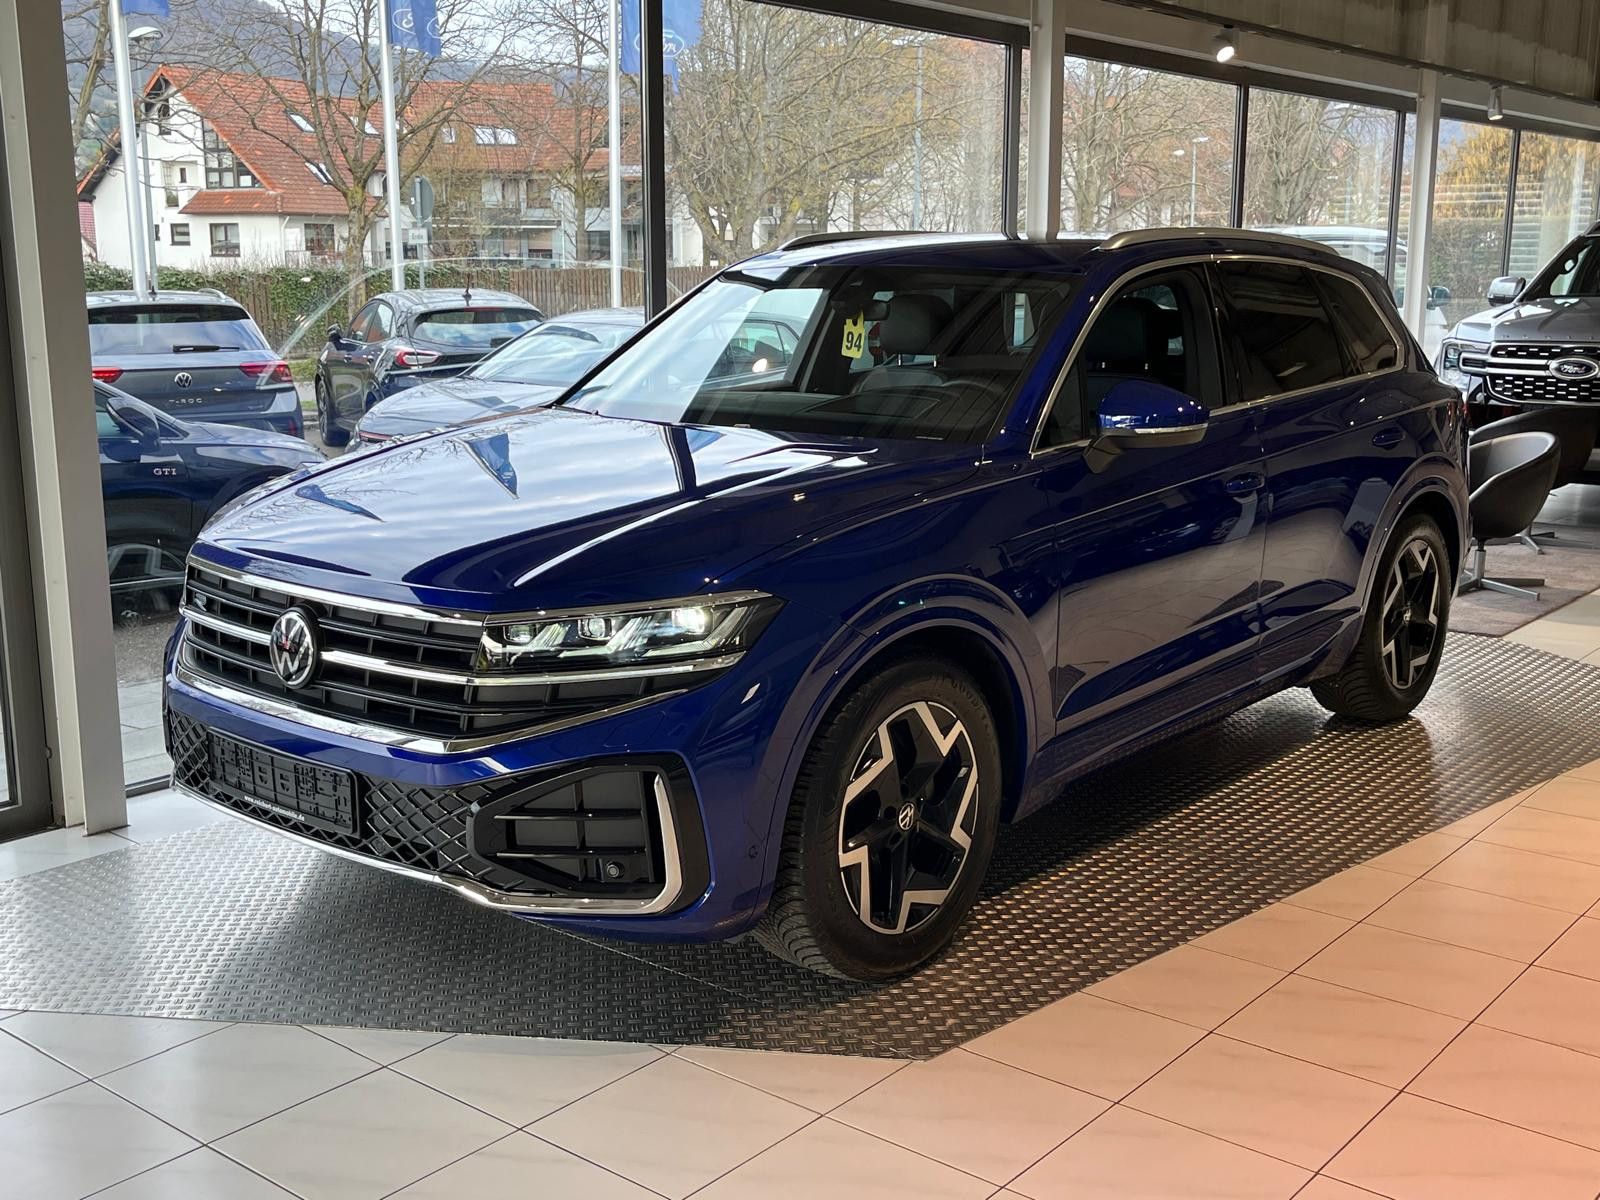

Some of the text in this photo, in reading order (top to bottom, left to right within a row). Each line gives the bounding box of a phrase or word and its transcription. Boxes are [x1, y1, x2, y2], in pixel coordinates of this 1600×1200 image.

[845, 331, 862, 351] 94
[1560, 364, 1586, 374] Ford
[153, 467, 177, 476] GTI
